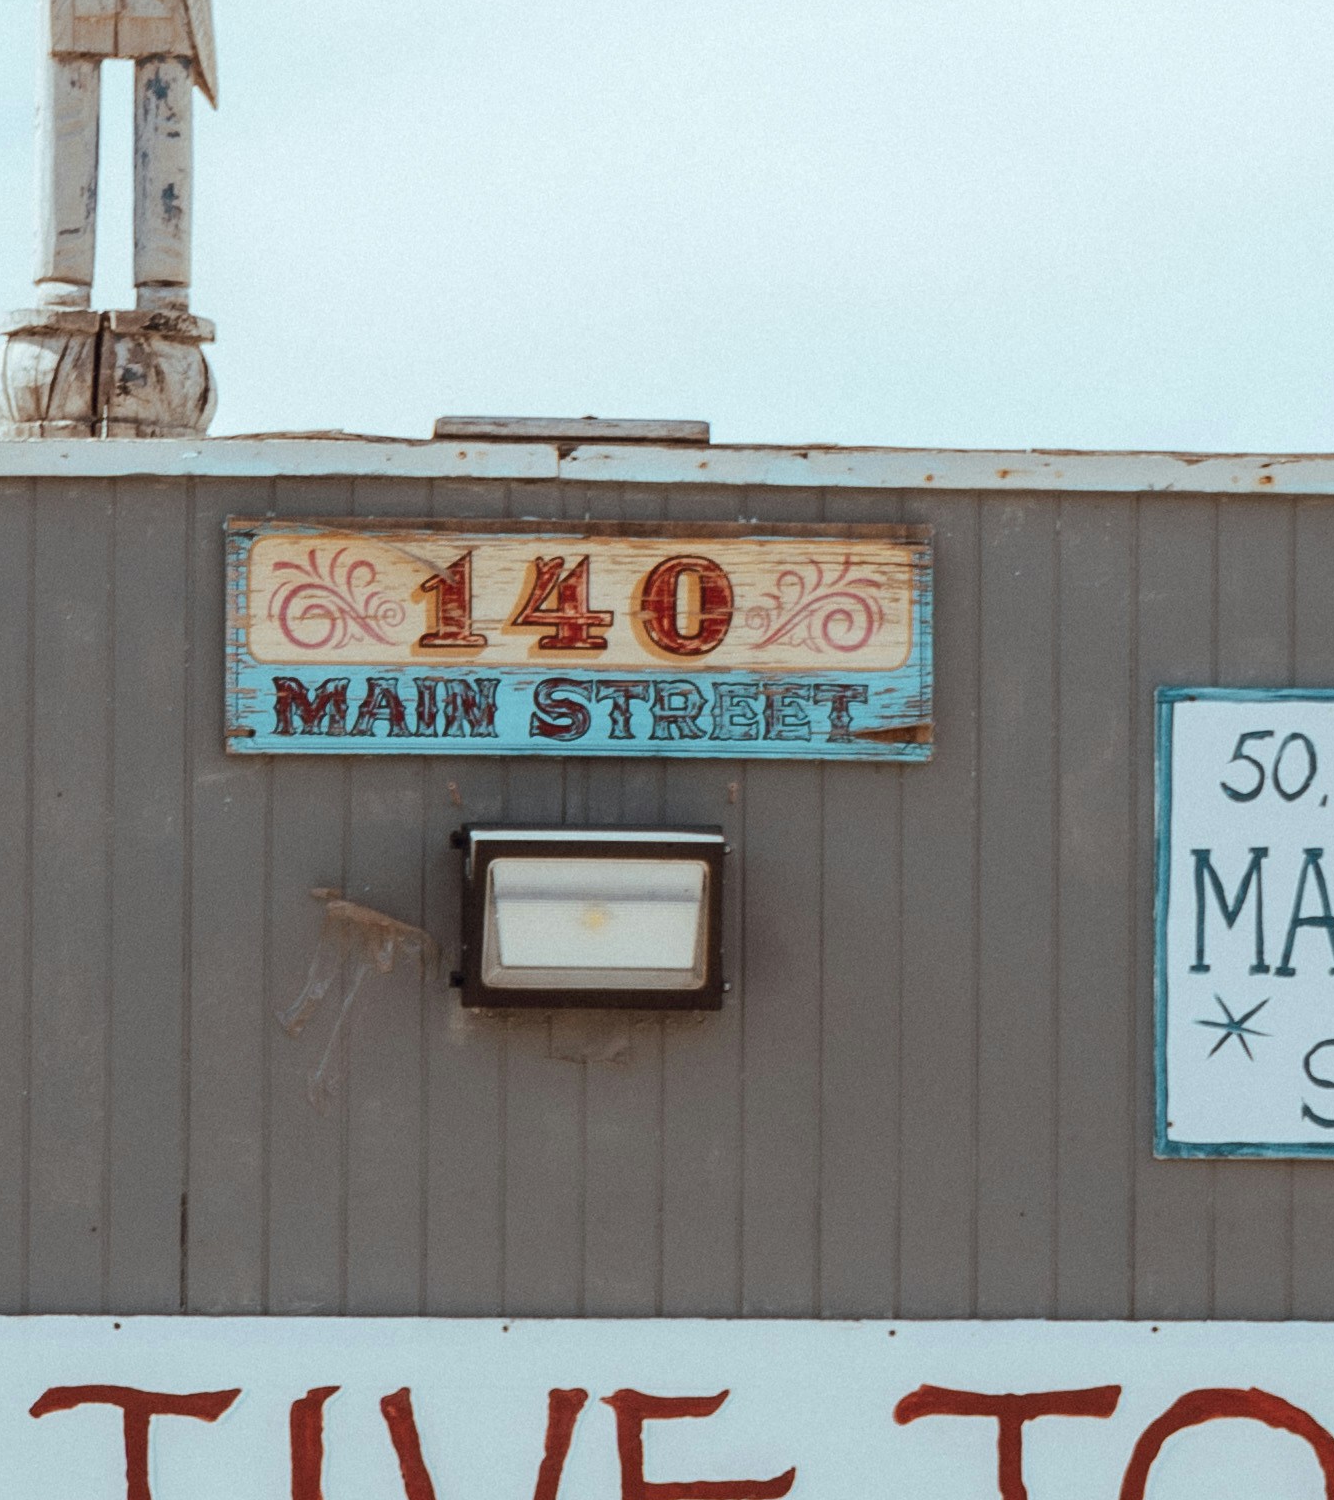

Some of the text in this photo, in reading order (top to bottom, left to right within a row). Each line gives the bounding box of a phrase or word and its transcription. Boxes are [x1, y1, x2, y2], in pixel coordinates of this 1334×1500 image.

[410, 545, 735, 658] 140
[272, 676, 869, 743] MAIN STREET
